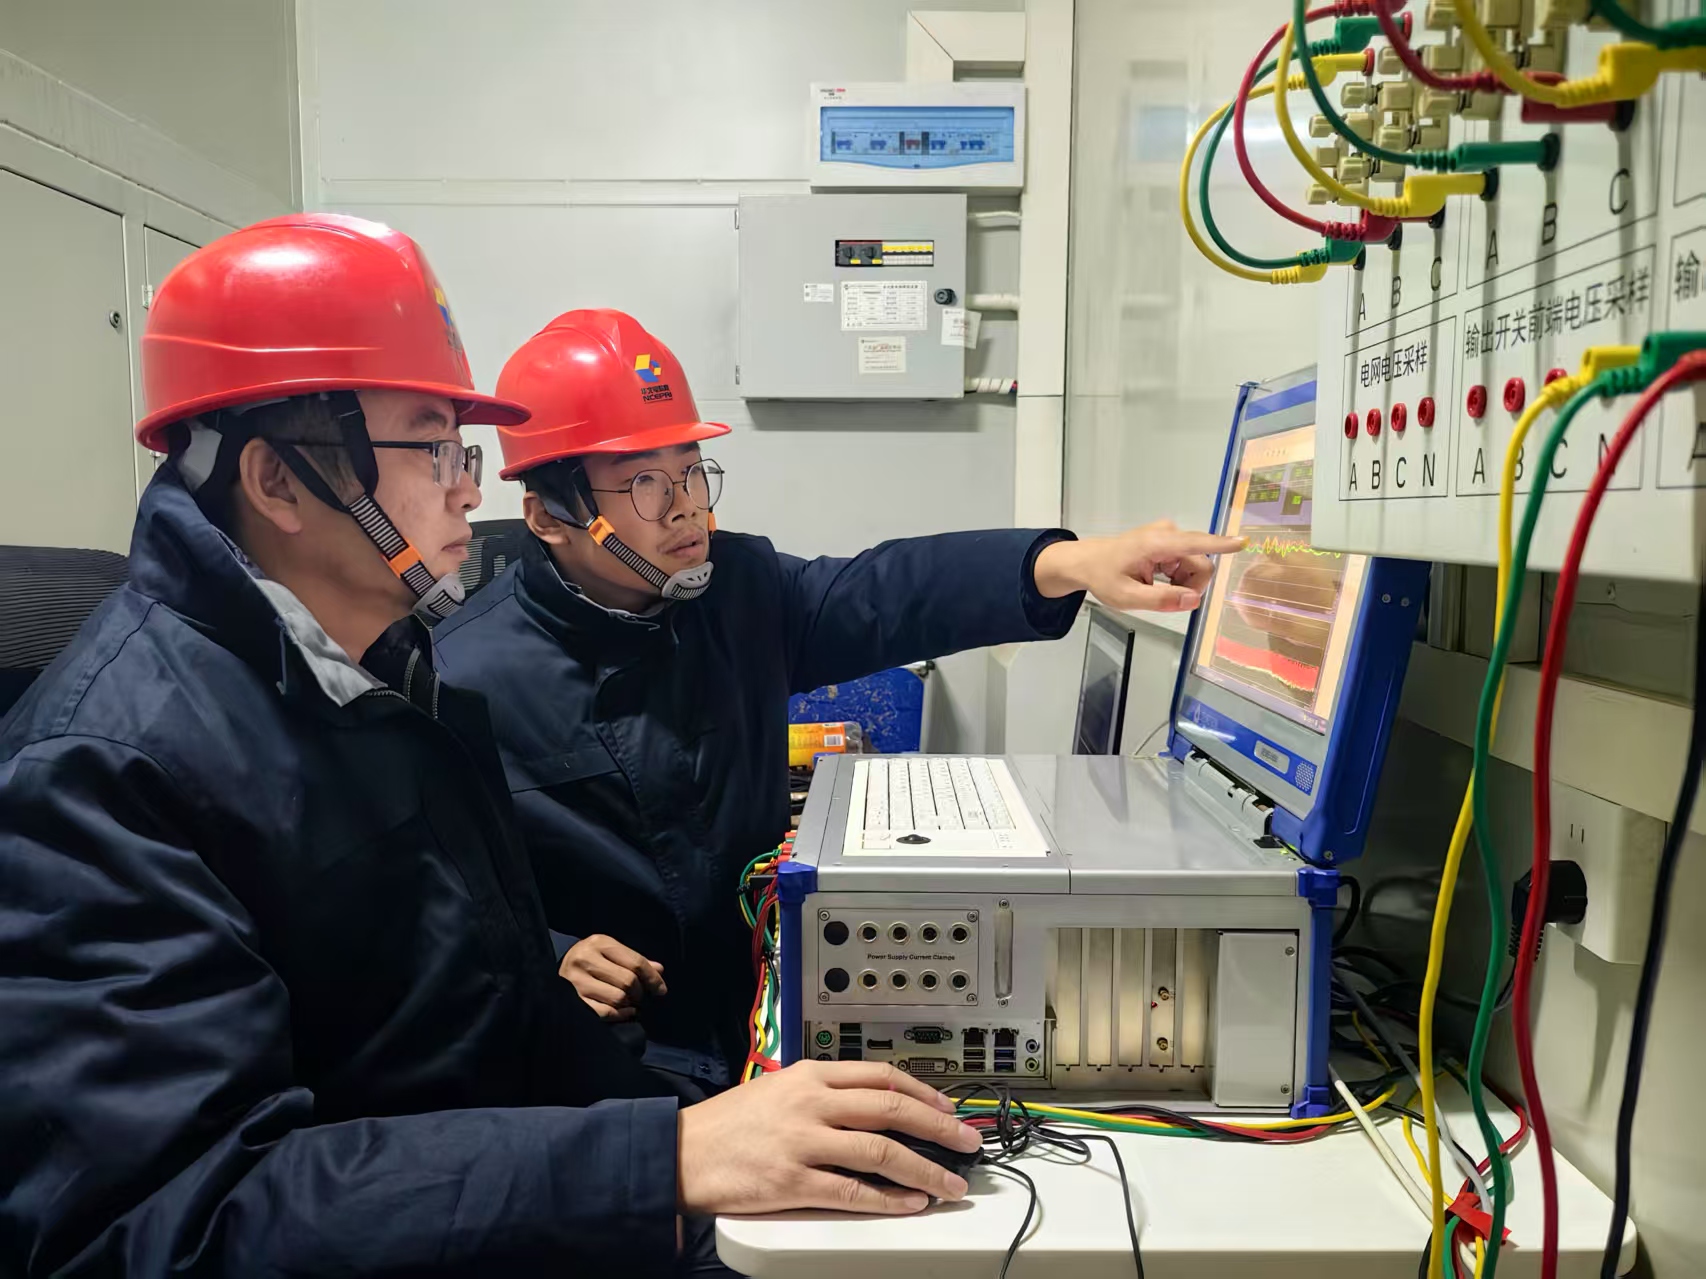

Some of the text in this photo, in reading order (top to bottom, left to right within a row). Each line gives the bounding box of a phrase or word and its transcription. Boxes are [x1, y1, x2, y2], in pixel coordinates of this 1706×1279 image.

[1486, 168, 1630, 270] A B C
[1358, 256, 1442, 328] A B C
[1465, 266, 1649, 359] 输出开关前端电压采样
[1361, 340, 1428, 388] 电网电压采样
[1349, 462, 1358, 491] A
[1371, 460, 1381, 489] B
[1396, 456, 1407, 488] C
[1422, 452, 1435, 487] N
[1472, 447, 1485, 484] A
[1550, 437, 1568, 479] C
[888, 953, 908, 961] Supply
